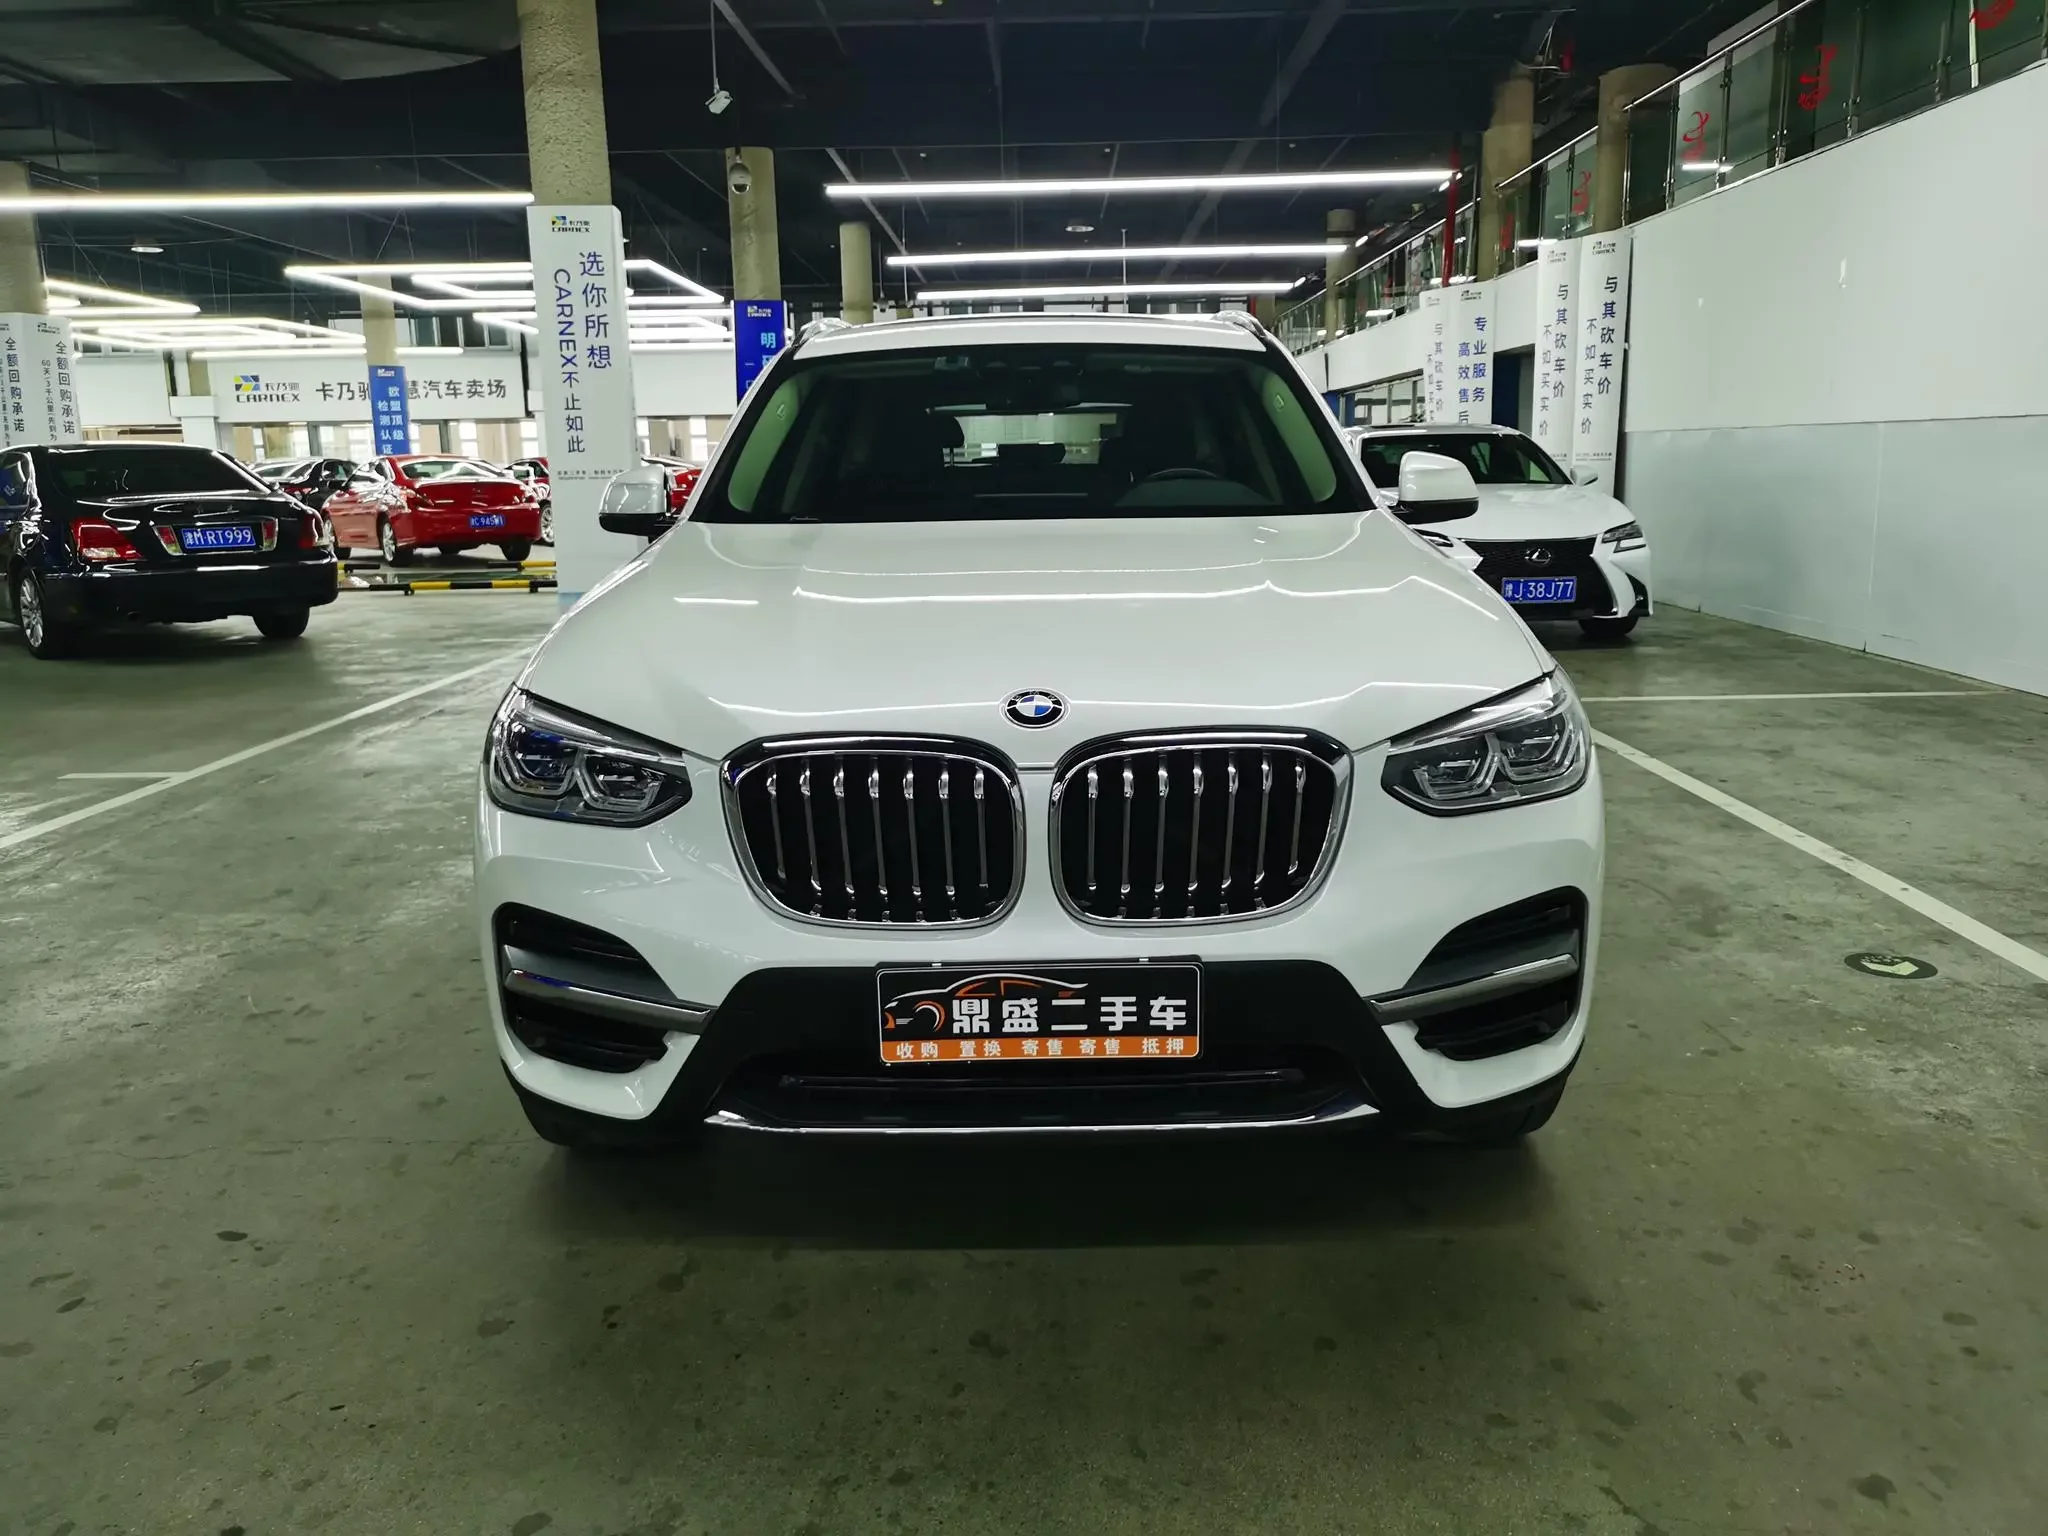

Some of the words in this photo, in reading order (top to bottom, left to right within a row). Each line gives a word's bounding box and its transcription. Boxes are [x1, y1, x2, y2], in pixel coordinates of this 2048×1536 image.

[579, 251, 611, 369] 选你所想
[1553, 284, 1569, 399] 与其砍车价
[1597, 275, 1618, 395] 与其砍车价
[5, 337, 25, 433] 全额回购承诺
[56, 341, 75, 434] 全额回购承诺
[236, 393, 300, 403] CARNEX
[1458, 341, 1470, 424] 高效售后
[1472, 316, 1487, 402] 专业服务
[1539, 324, 1552, 436] 不如买实价
[1581, 318, 1598, 435] 不如买实价
[896, 1040, 939, 1059] 收购
[959, 1039, 1002, 1058] 置换
[1021, 1038, 1063, 1057] 寄售
[1079, 1037, 1120, 1056] 寄售
[1141, 1036, 1184, 1056] 抵押
[952, 996, 1187, 1034] 鼎盛二手车
